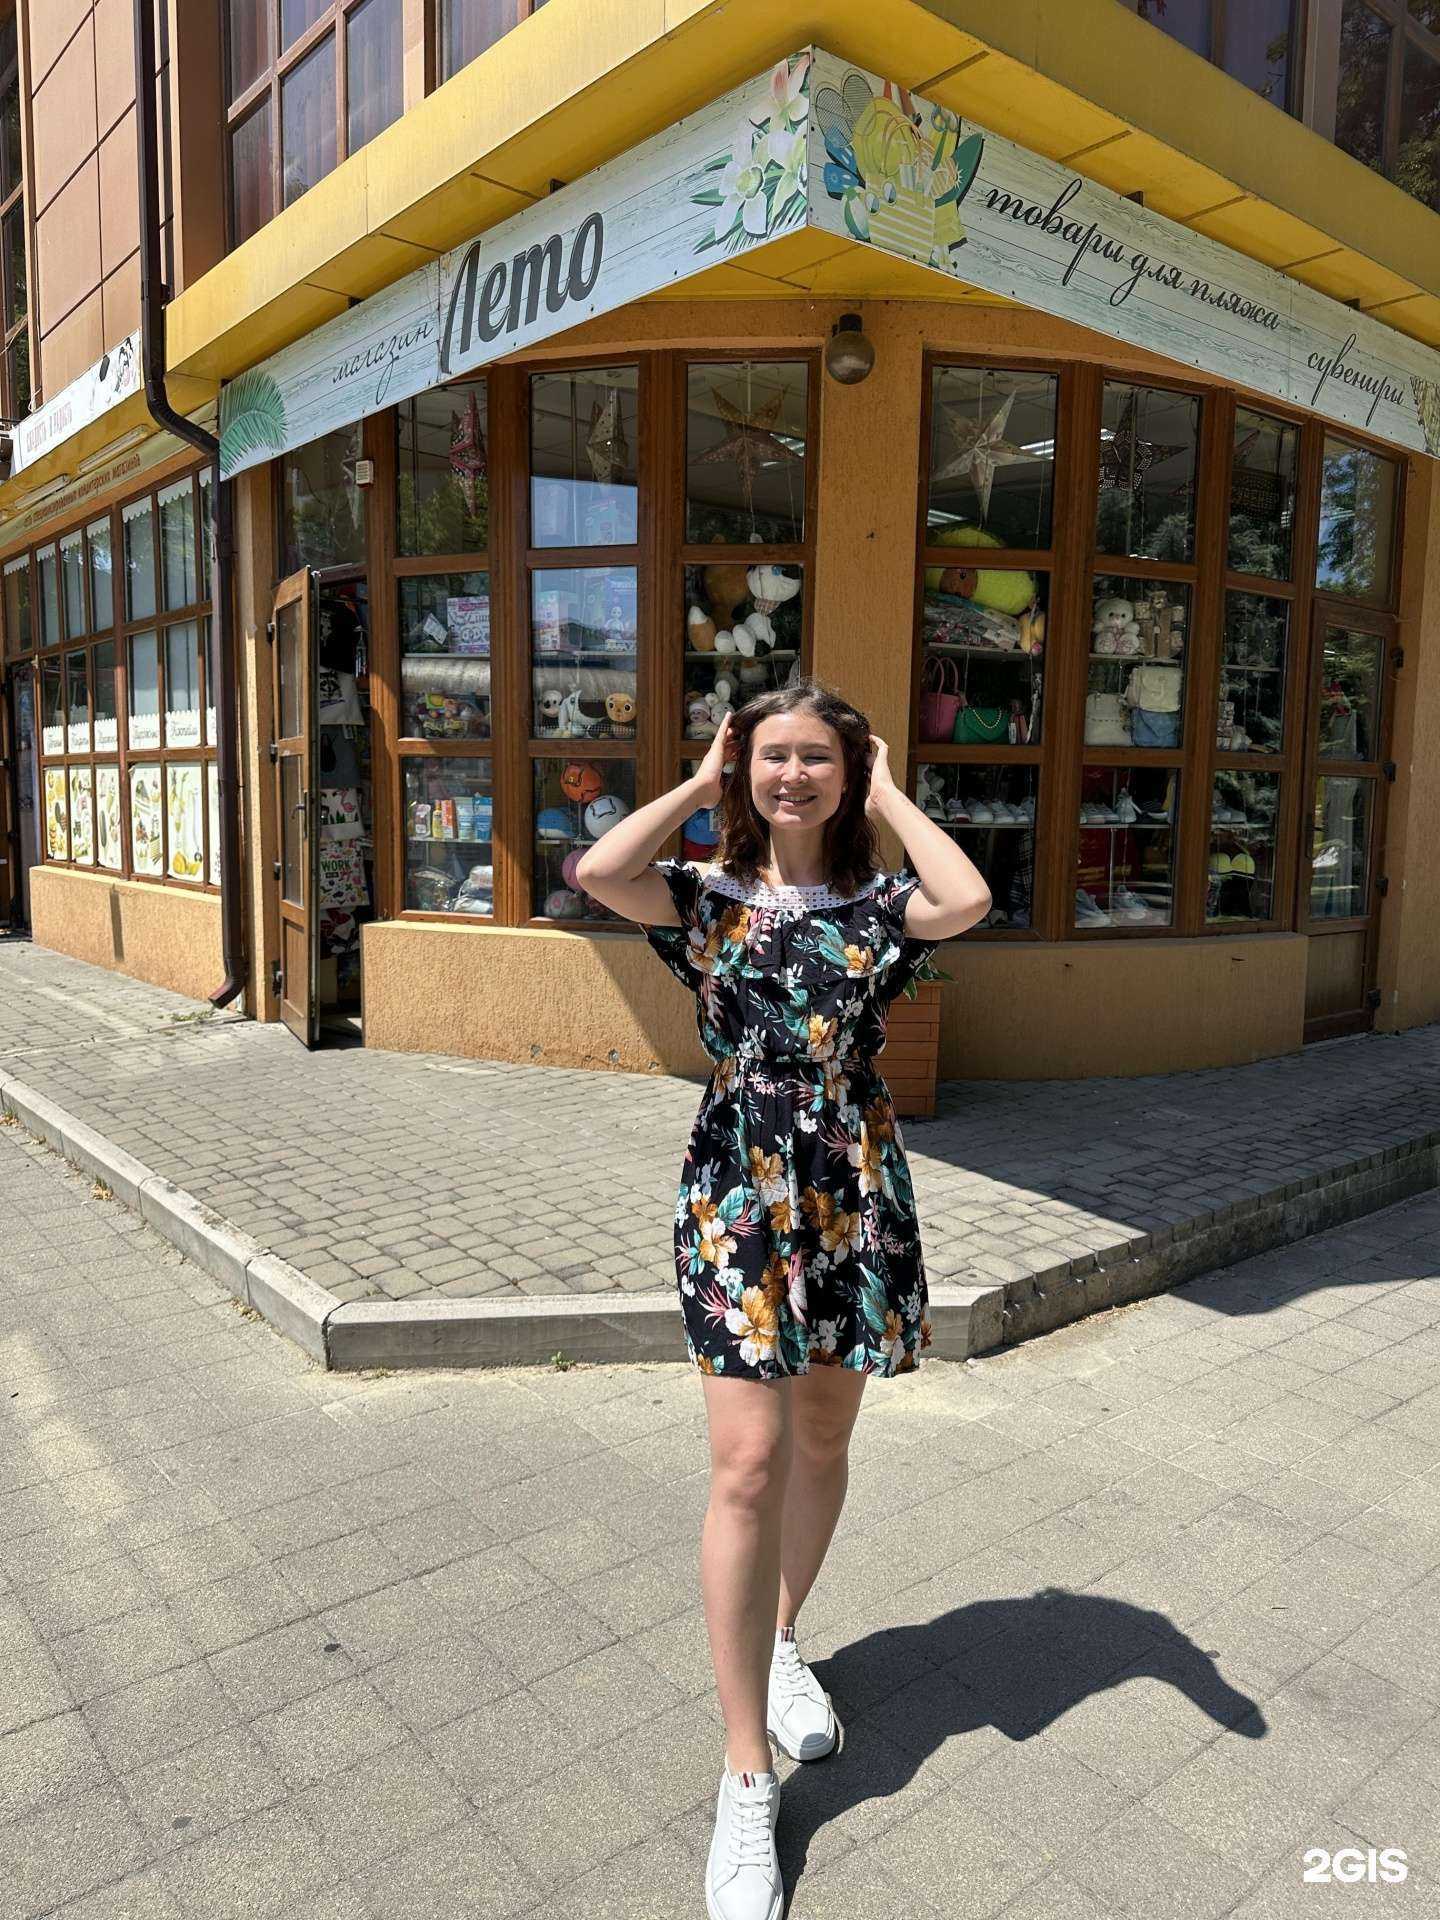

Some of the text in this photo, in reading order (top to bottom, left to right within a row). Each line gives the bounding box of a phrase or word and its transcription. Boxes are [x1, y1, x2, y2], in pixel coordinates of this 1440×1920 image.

[332, 211, 604, 406] магазин Лето
[985, 178, 1282, 330] товары для пляжа
[1307, 333, 1404, 426] сувениры
[320, 860, 352, 872] WORK
